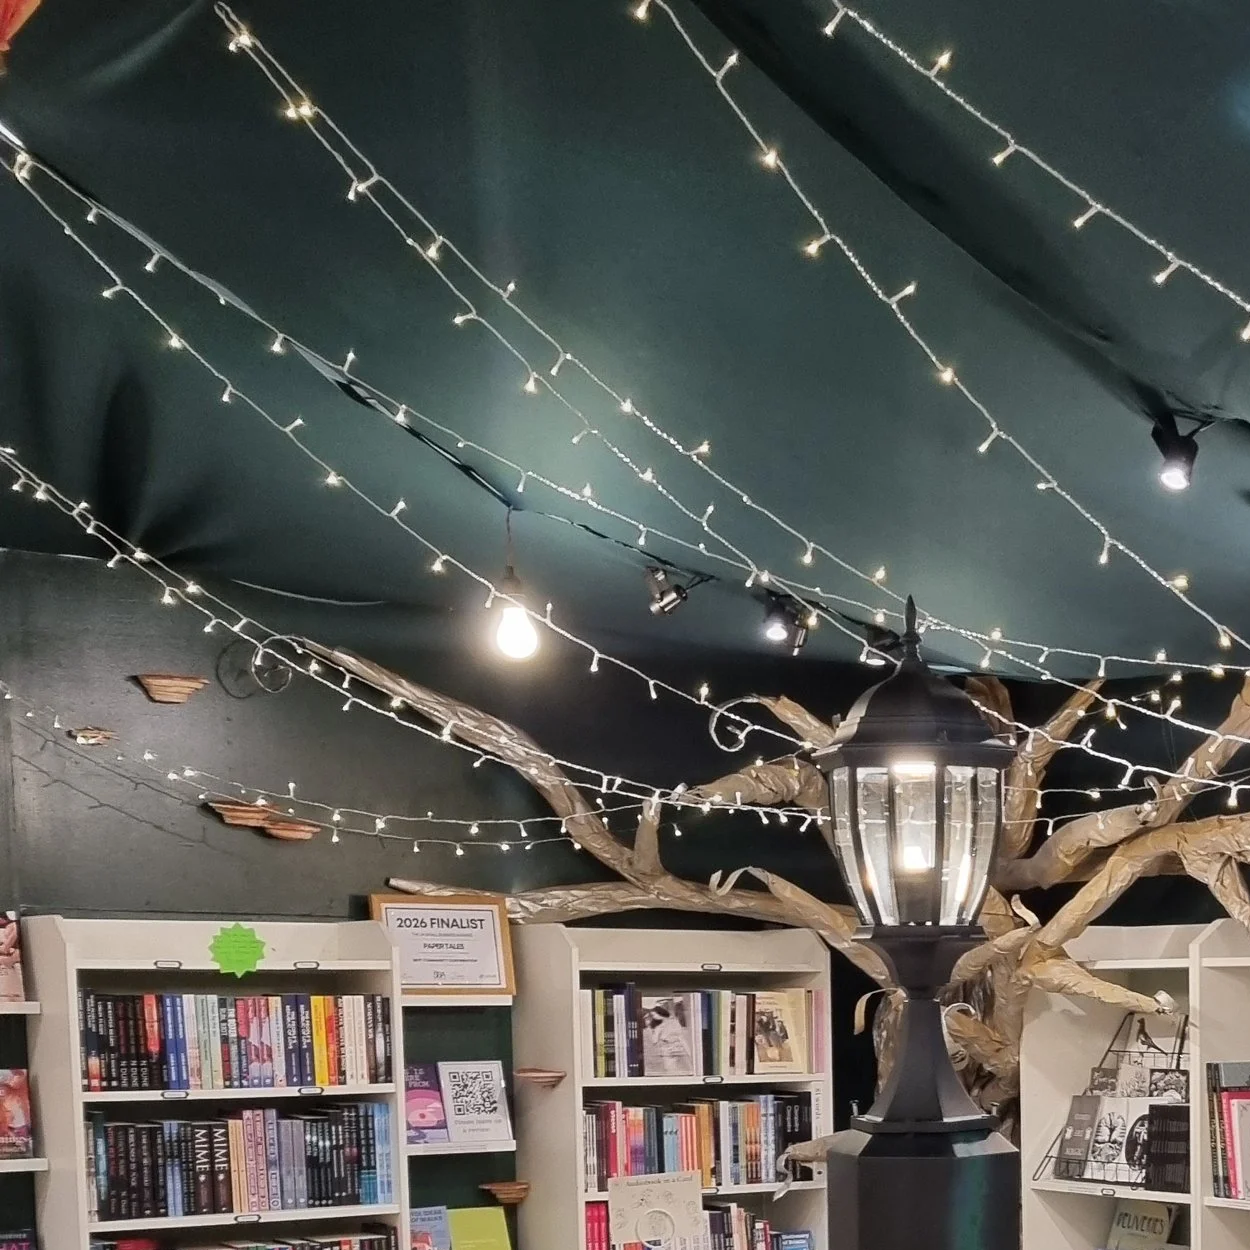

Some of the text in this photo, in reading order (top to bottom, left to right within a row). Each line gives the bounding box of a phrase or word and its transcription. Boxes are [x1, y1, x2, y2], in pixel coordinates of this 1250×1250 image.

[396, 917, 486, 930] 2026 FINALIST
[131, 1068, 139, 1087] DUNE
[141, 1068, 149, 1087] DUNE
[195, 1129, 210, 1172] MIME
[213, 1128, 228, 1171] MIME
